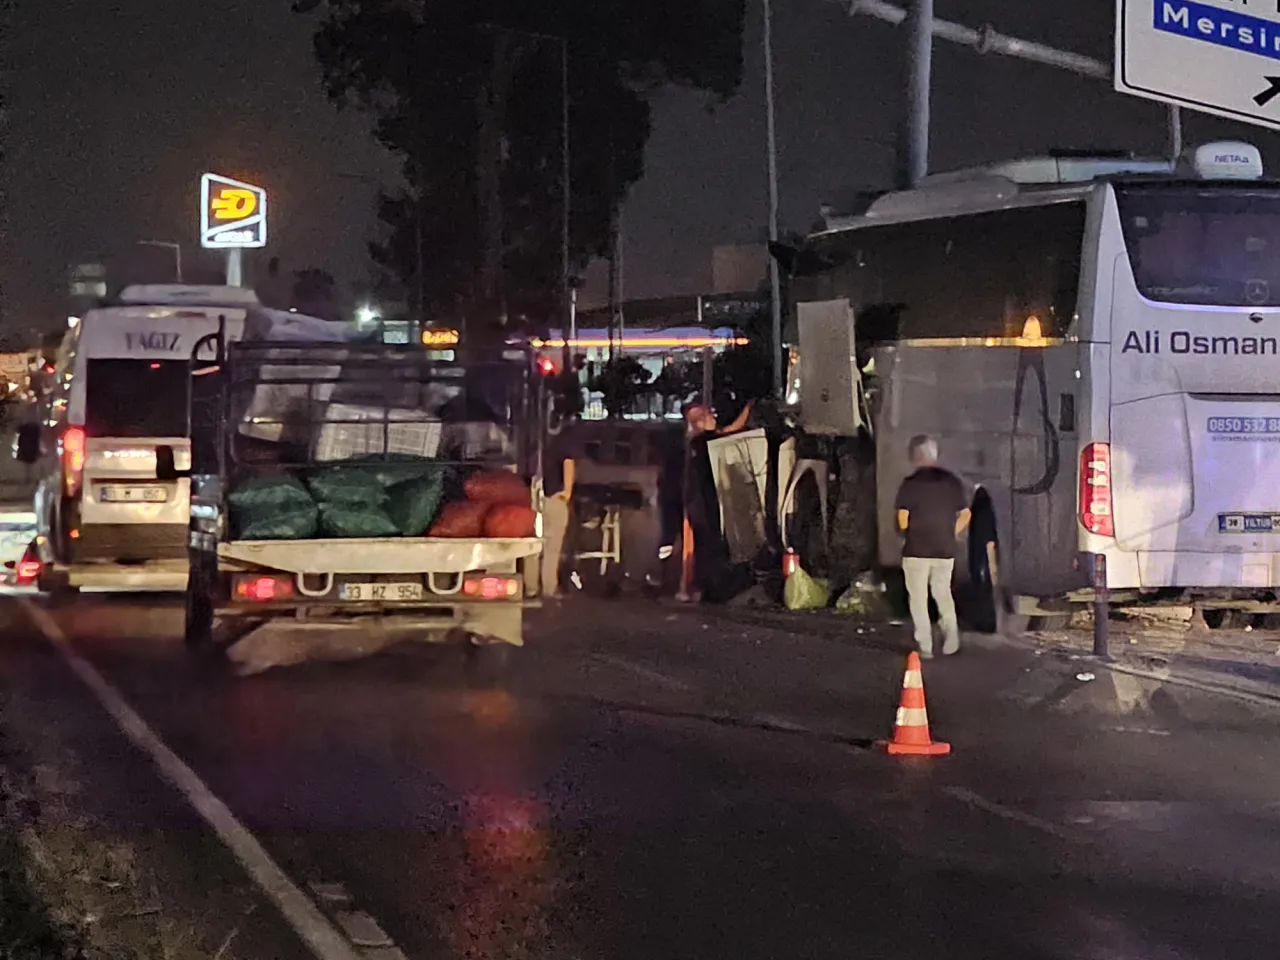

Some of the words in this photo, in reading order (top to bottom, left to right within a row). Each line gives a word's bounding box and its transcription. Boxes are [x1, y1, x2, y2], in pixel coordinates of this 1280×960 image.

[1121, 330, 1160, 354] Ali
[1170, 331, 1278, 355] Osman
[1209, 418, 1242, 432] 0850
[1244, 418, 1267, 432] 532
